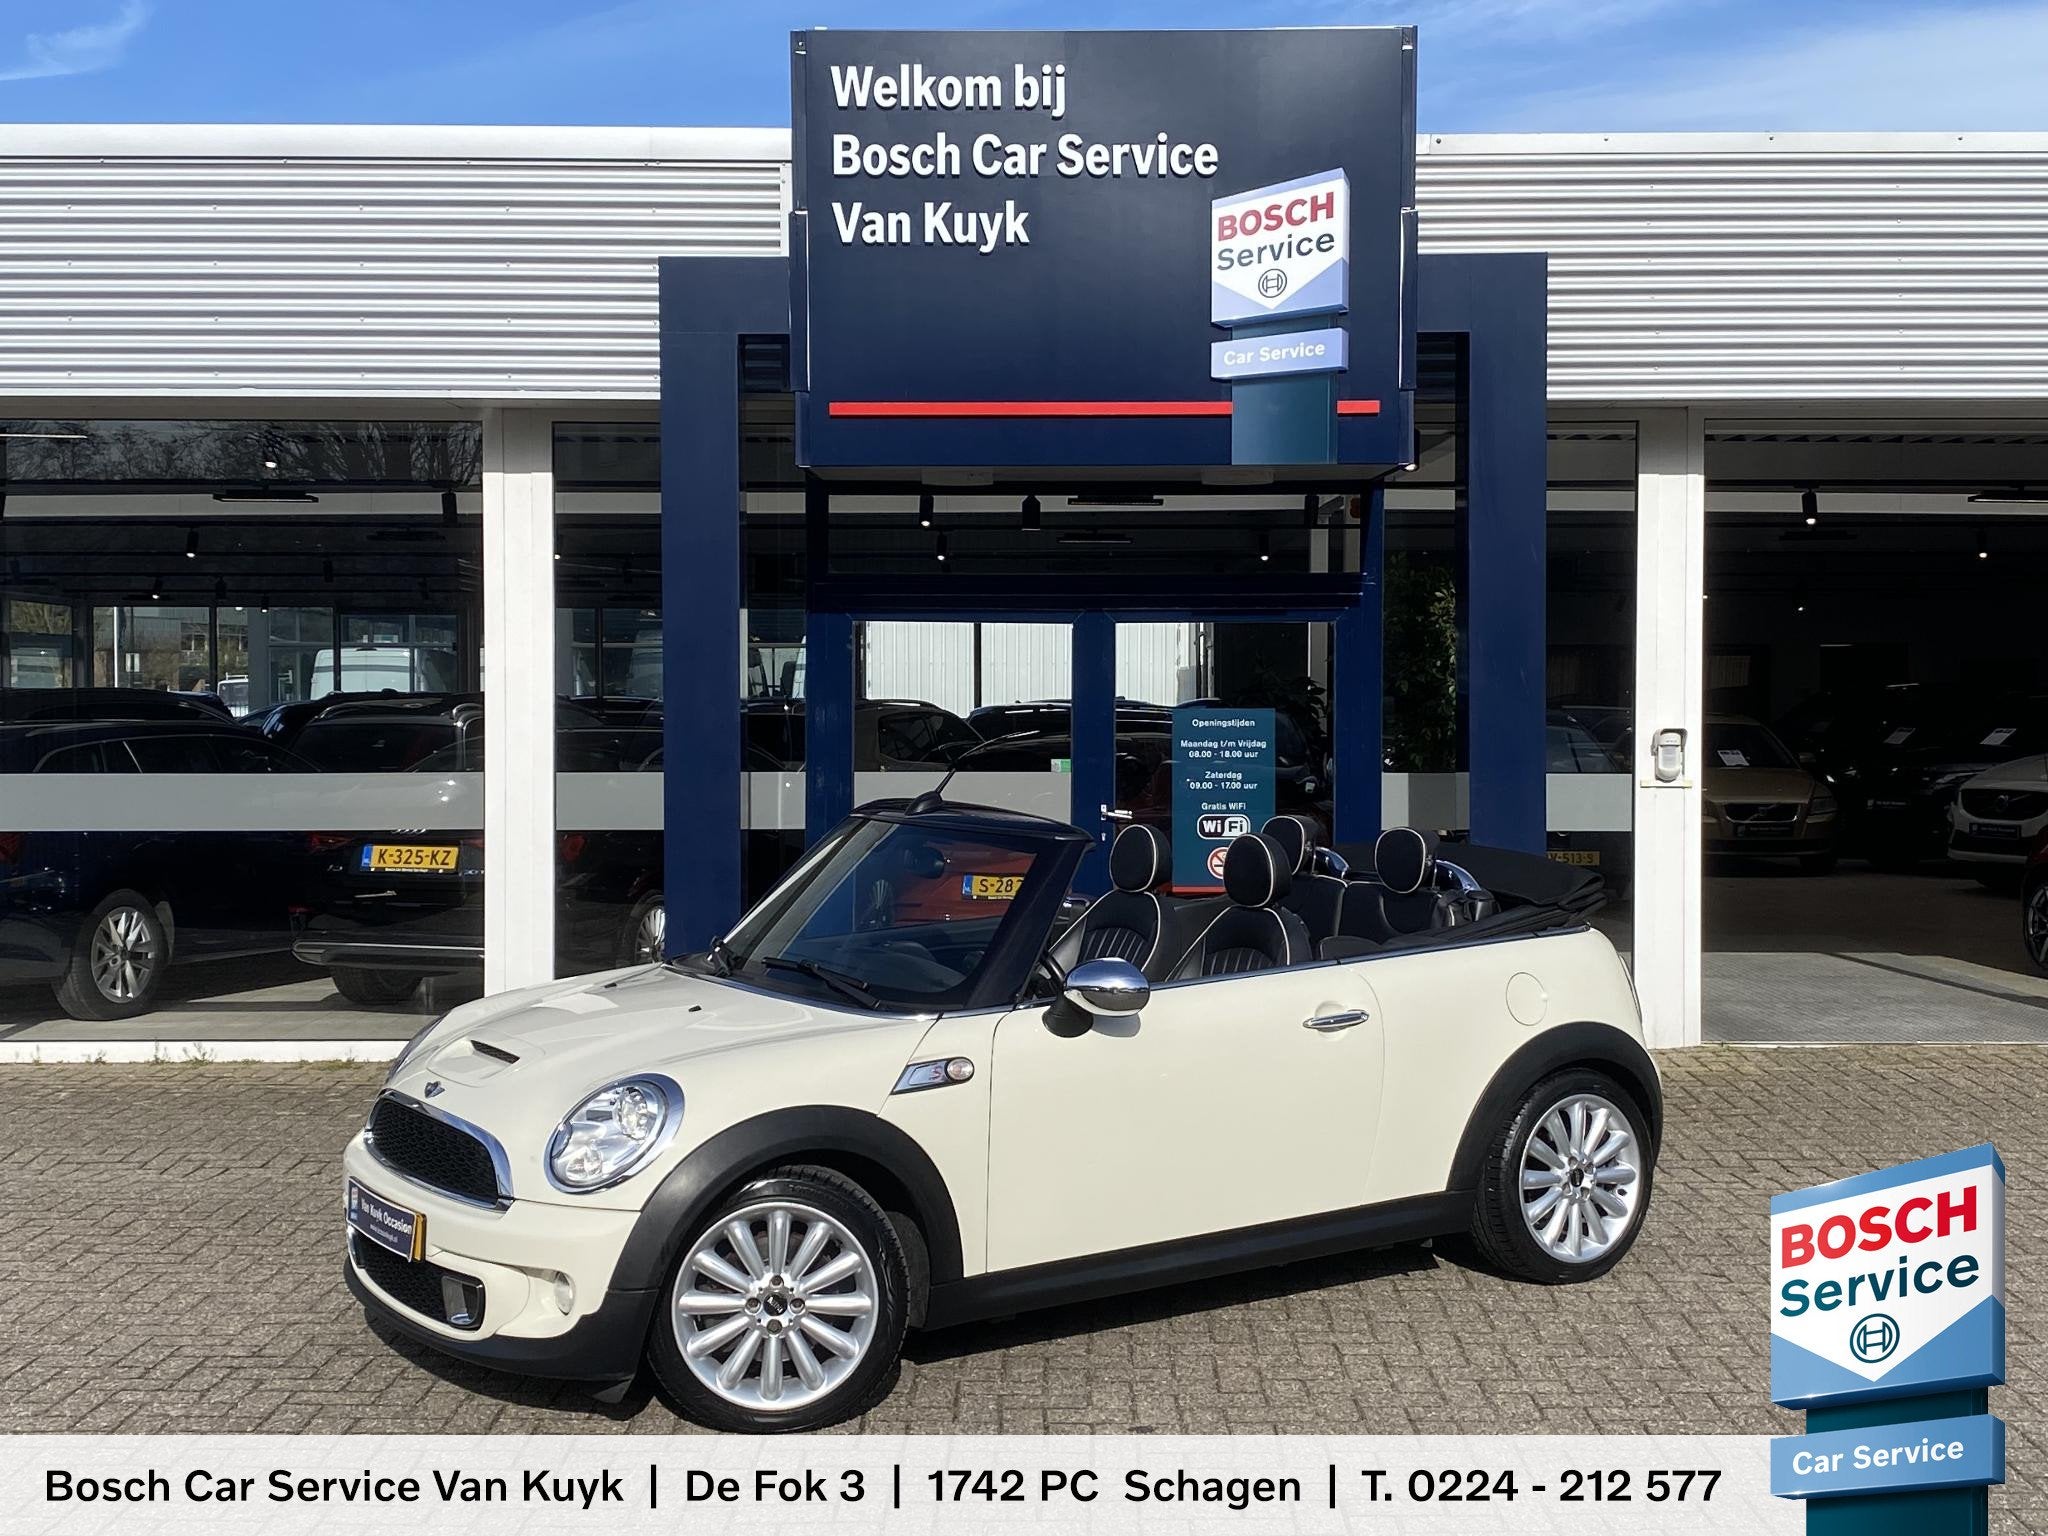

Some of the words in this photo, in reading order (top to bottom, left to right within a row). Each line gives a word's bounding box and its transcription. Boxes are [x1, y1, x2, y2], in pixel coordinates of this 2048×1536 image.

[831, 63, 1002, 108] Welkom
[1014, 63, 1066, 117] bij
[833, 132, 961, 176] Bosch
[972, 134, 1048, 176] Car
[1056, 132, 1219, 176] Service
[1218, 192, 1334, 241] BOSCH
[831, 202, 911, 244] Van
[924, 200, 1030, 253] Kuyk
[1217, 233, 1335, 270] Service
[1224, 351, 1254, 366] Car
[1259, 342, 1326, 362] Service
[1191, 718, 1256, 728] Openingstijden
[1180, 739, 1219, 749] Maandag
[1220, 739, 1236, 748] t/m
[1238, 739, 1267, 749] Vrijdag
[1188, 750, 1212, 758] 08.00
[1219, 750, 1242, 758] 18.00
[1204, 771, 1243, 781] Zaterdag
[1189, 782, 1213, 790] 09.00
[1220, 782, 1242, 790] 17.00
[1201, 802, 1227, 811] Gratis
[378, 848, 452, 866] K-325-KZ
[978, 878, 1024, 893] S-28
[383, 1211, 412, 1236] Occasion
